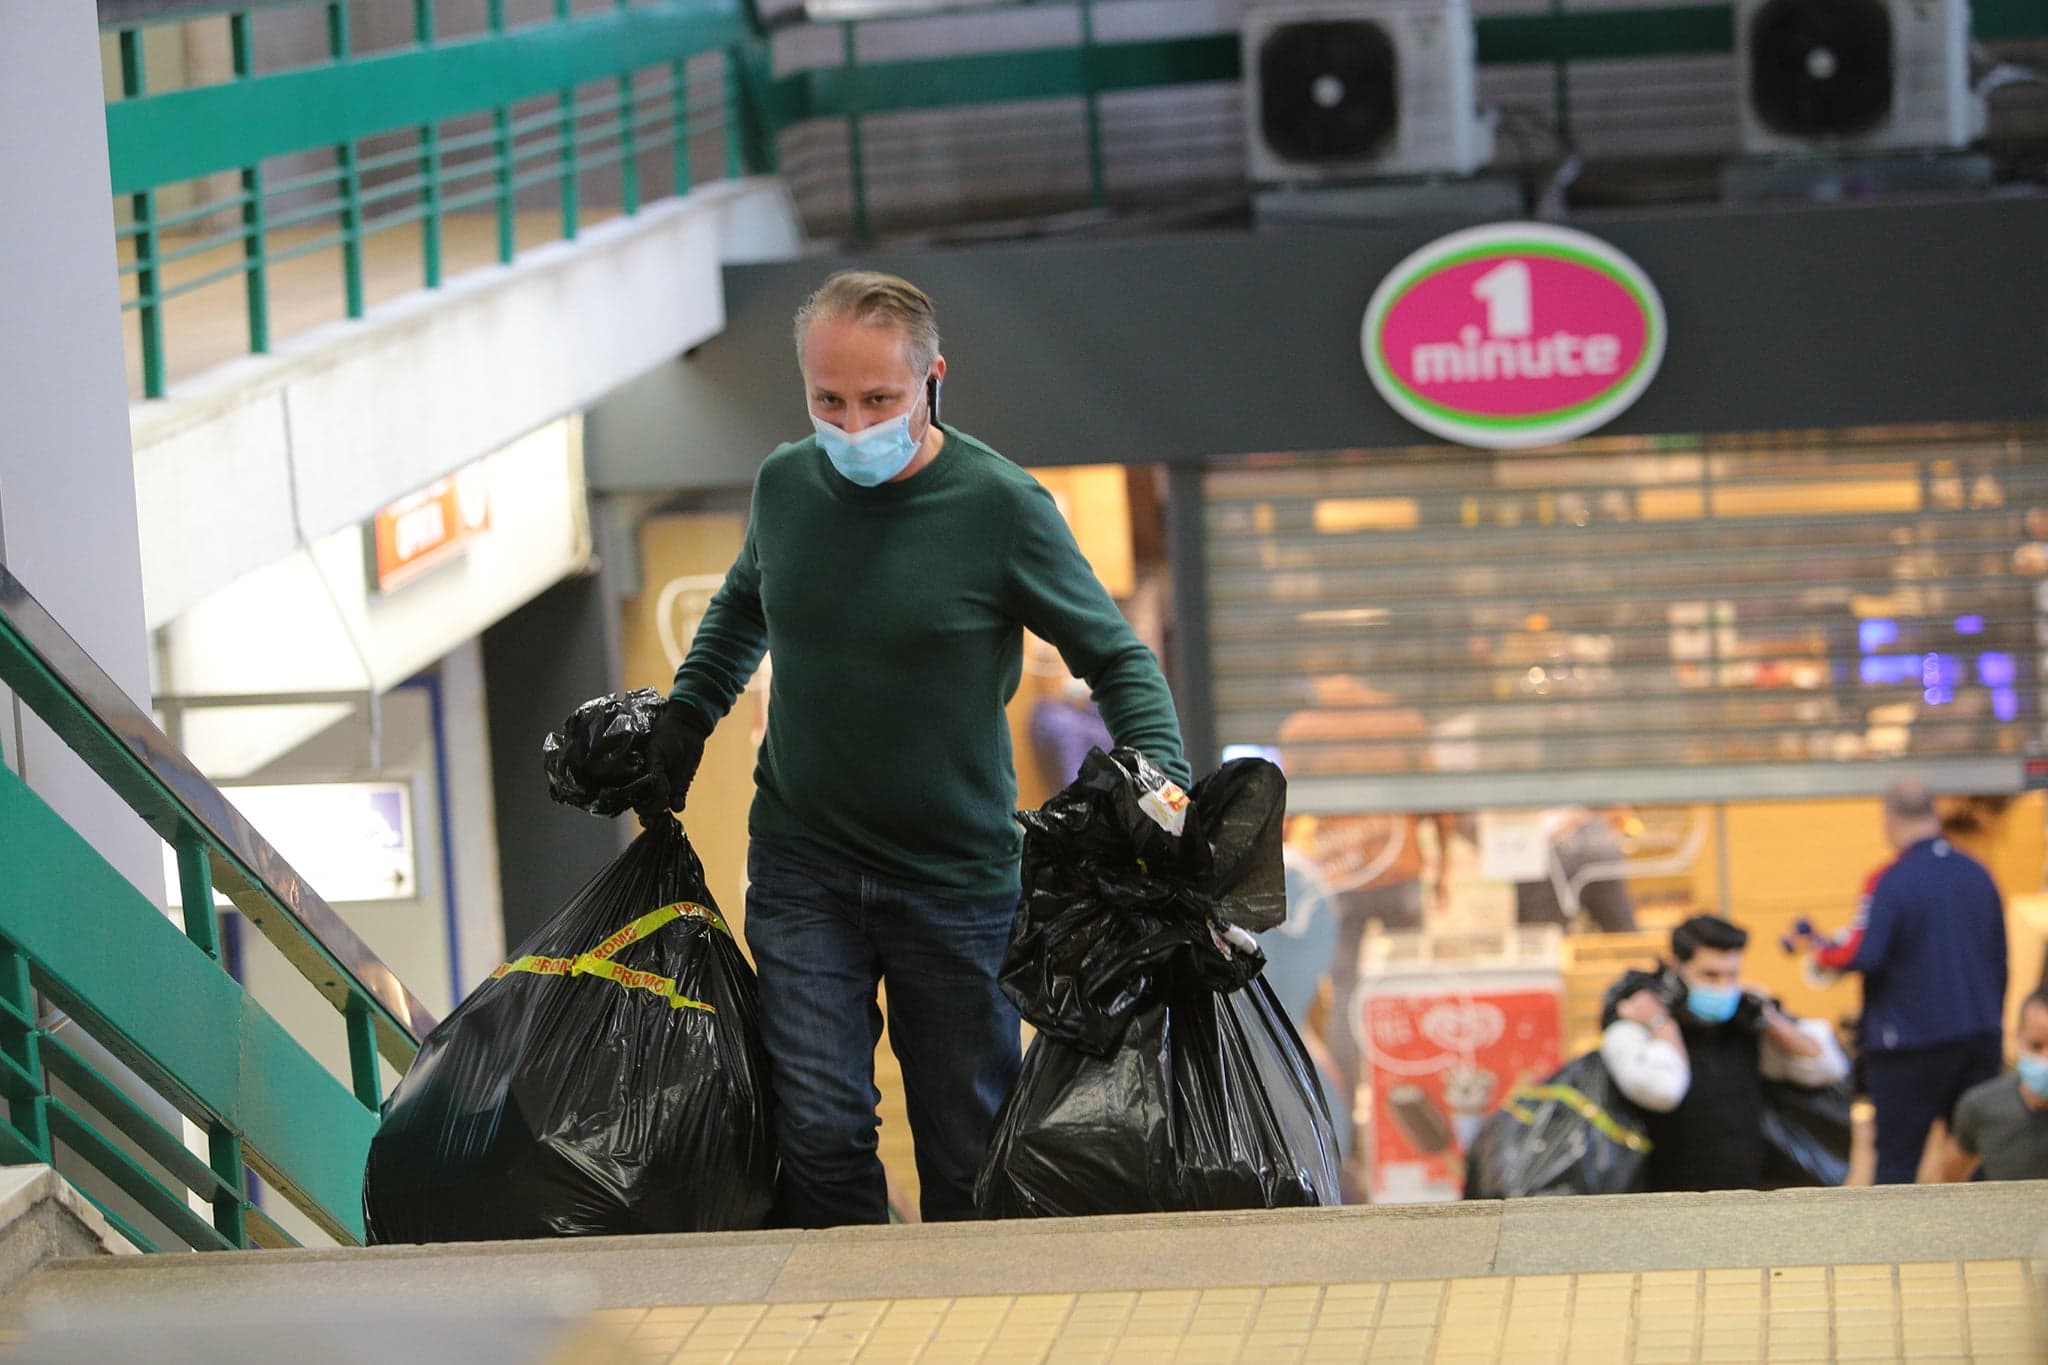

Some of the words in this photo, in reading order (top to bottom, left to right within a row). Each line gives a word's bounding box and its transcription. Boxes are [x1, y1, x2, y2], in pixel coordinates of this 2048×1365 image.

[1472, 260, 1532, 337] 1
[1412, 325, 1620, 384] minute
[594, 927, 638, 959] ROMO
[530, 958, 571, 973] PROM
[611, 965, 666, 992] PROMO
